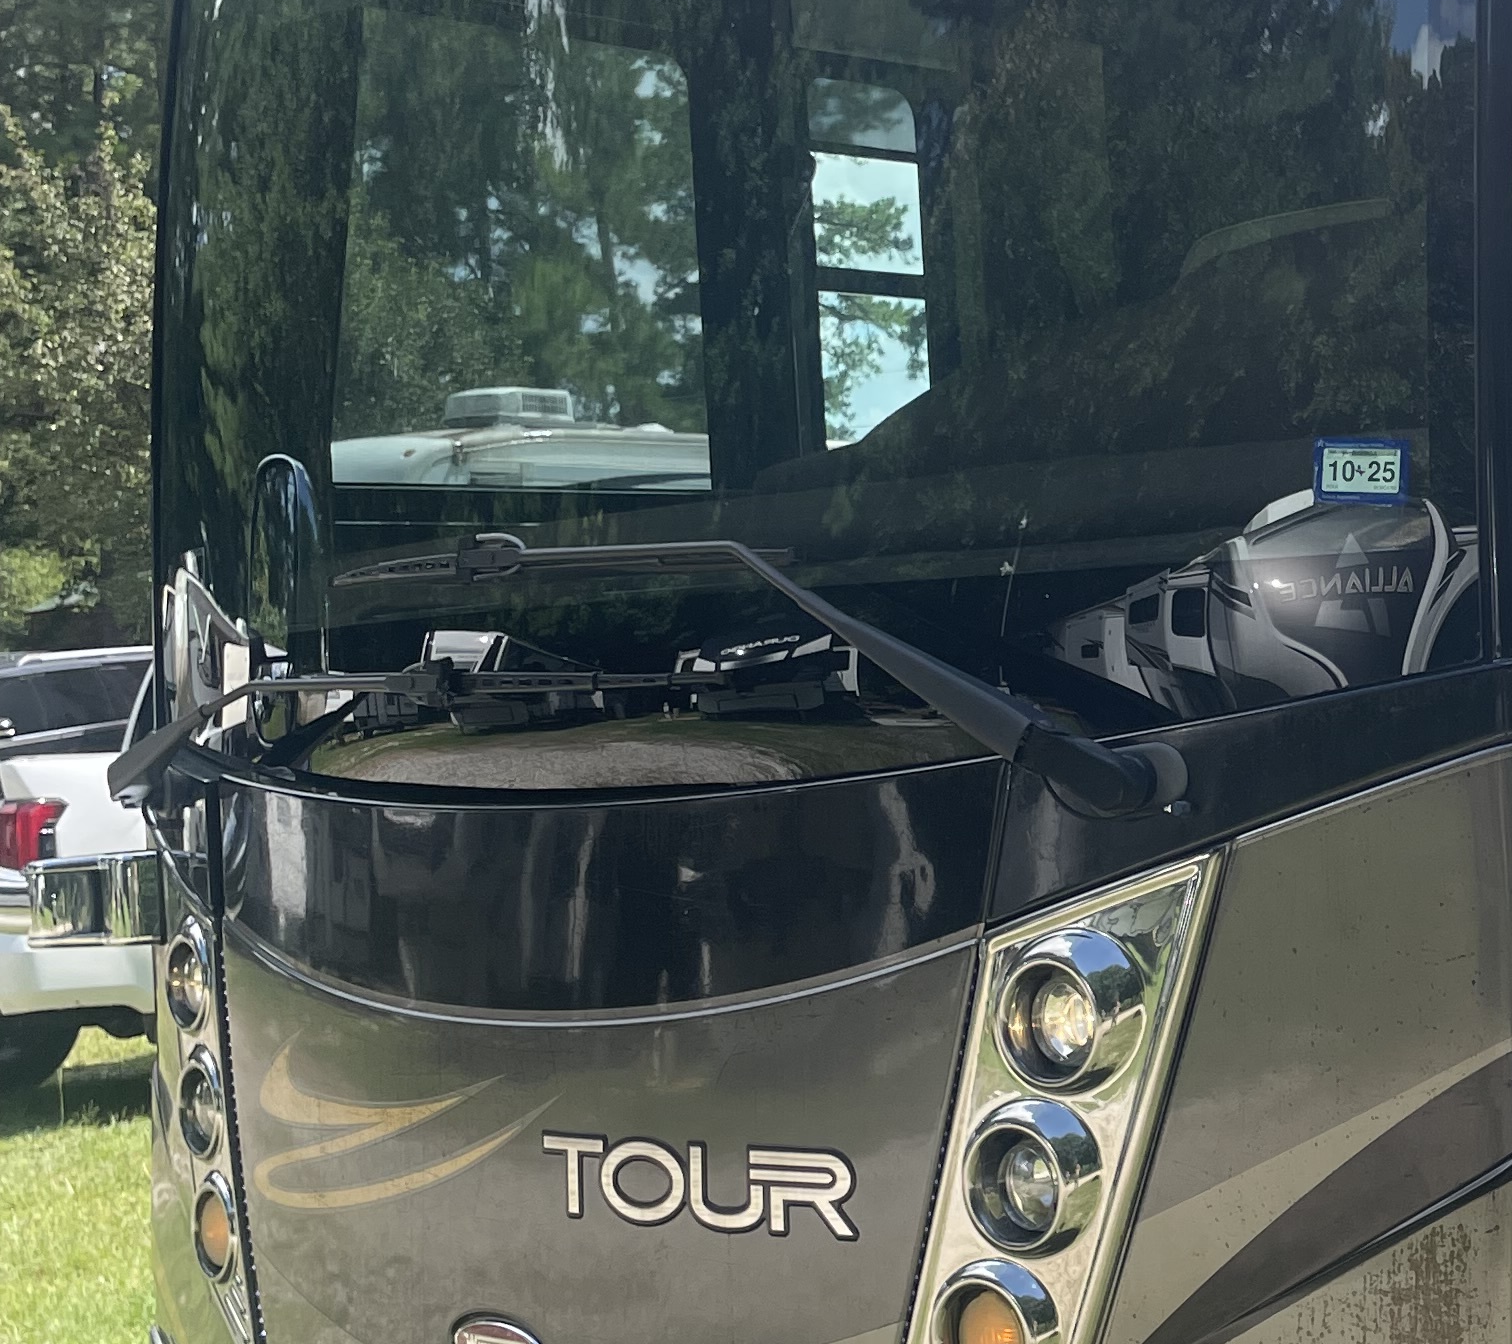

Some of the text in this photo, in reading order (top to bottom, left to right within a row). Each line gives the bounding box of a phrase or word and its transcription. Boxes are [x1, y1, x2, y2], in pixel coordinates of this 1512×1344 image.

[1328, 460, 1396, 483] 10 25
[541, 1129, 860, 1242] TOUR
